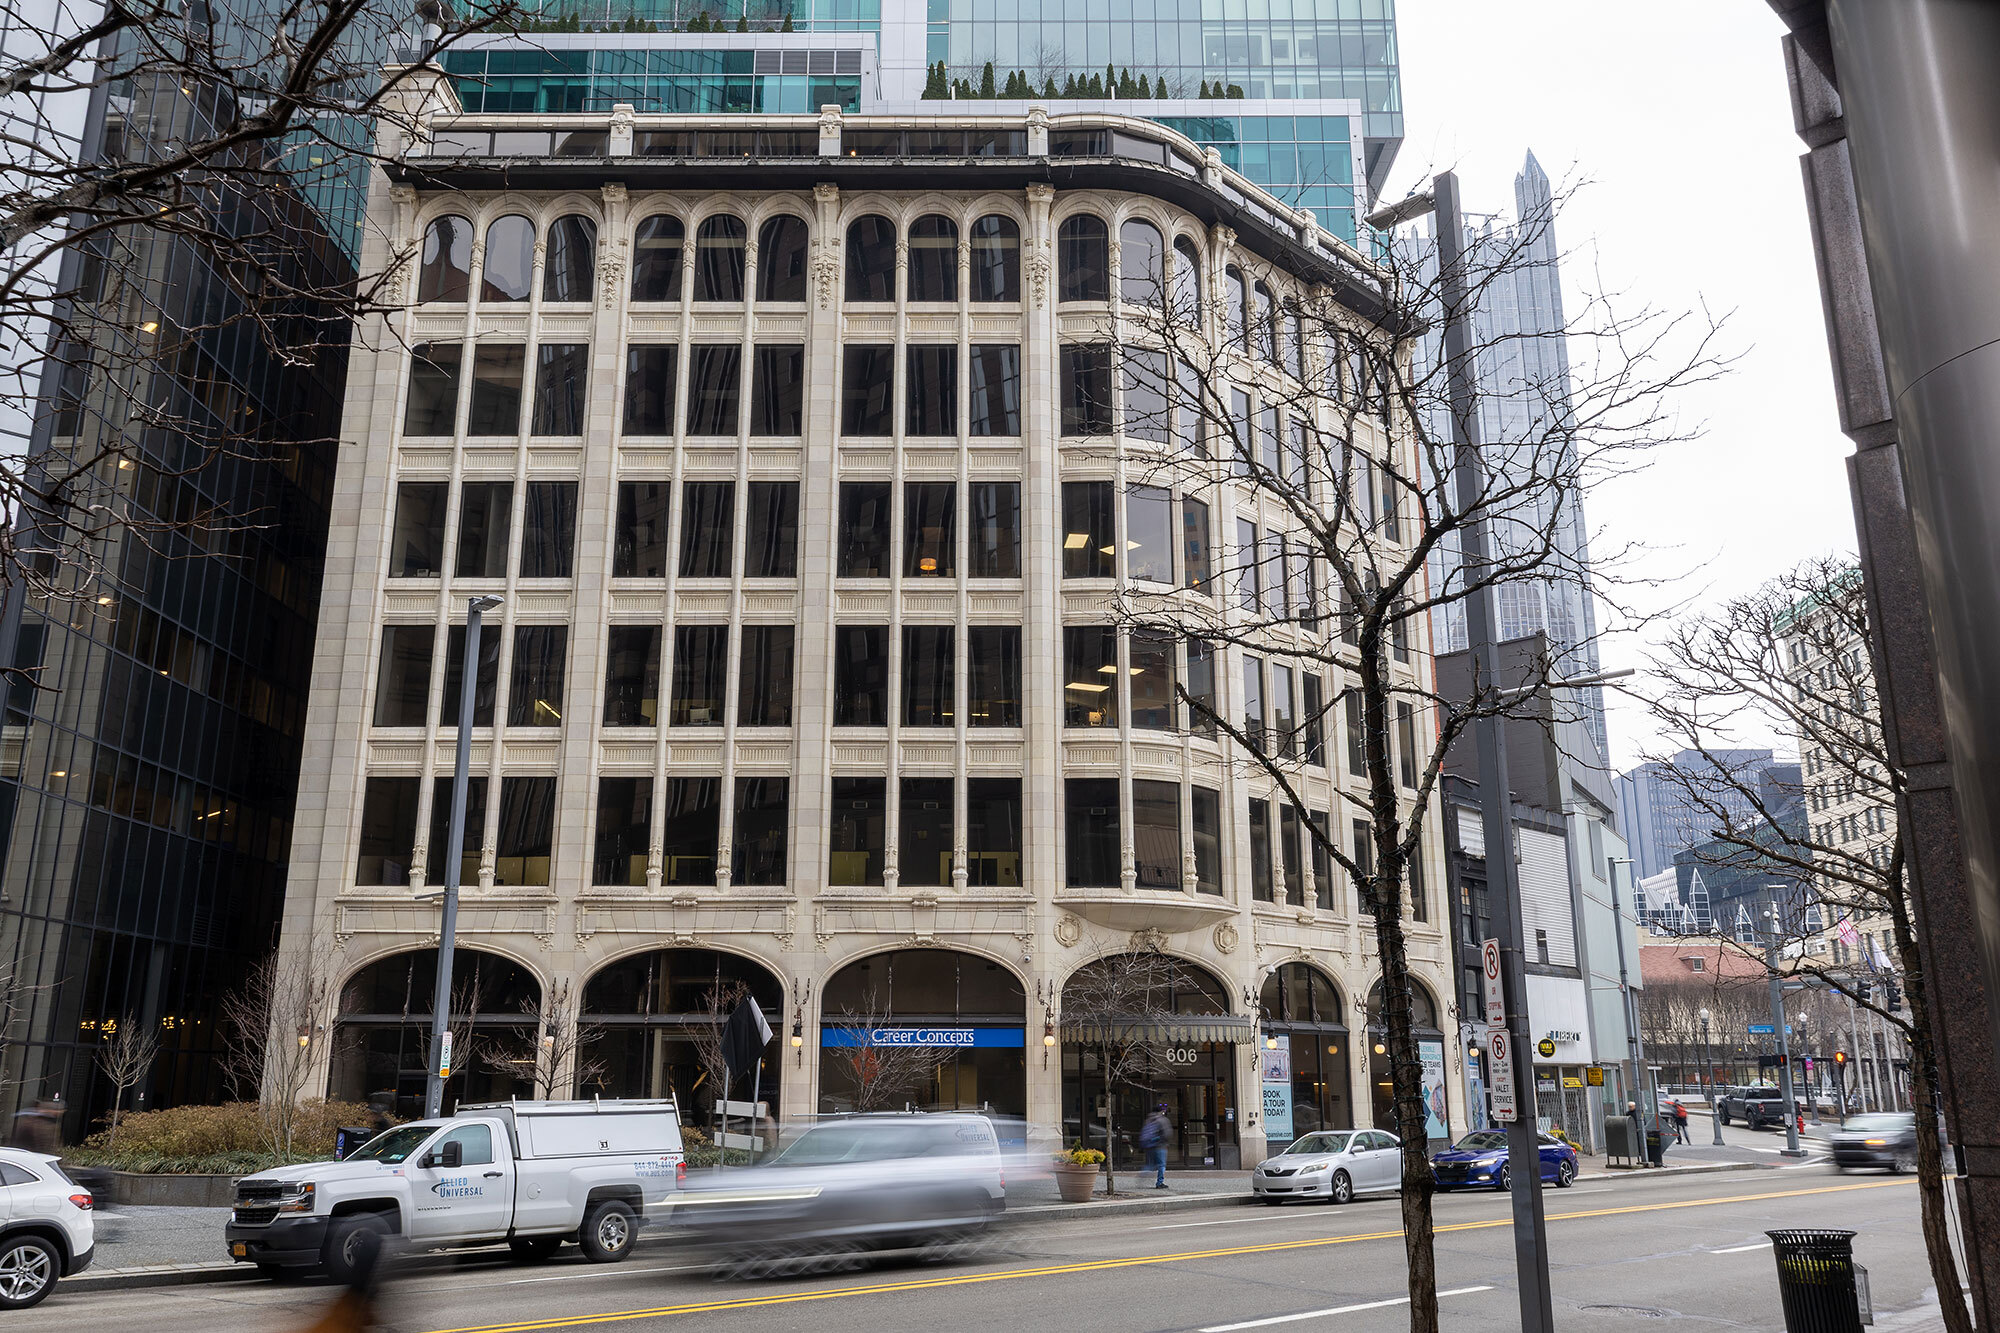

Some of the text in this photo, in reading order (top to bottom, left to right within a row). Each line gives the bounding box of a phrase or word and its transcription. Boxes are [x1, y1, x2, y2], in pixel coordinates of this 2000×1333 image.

[871, 1029, 975, 1045] Career Concepts
[1420, 1045, 1436, 1053] LEXIBLE
[1166, 1048, 1198, 1063] 606
[1495, 1084, 1509, 1093] VALET
[1263, 1090, 1281, 1099] BOOK
[1263, 1099, 1286, 1108] A TOUR
[1494, 1095, 1513, 1104] SERVICE
[1264, 1108, 1286, 1117] TODAY!
[440, 1177, 468, 1187] ALLIED
[440, 1187, 483, 1198] UNIVERSAL
